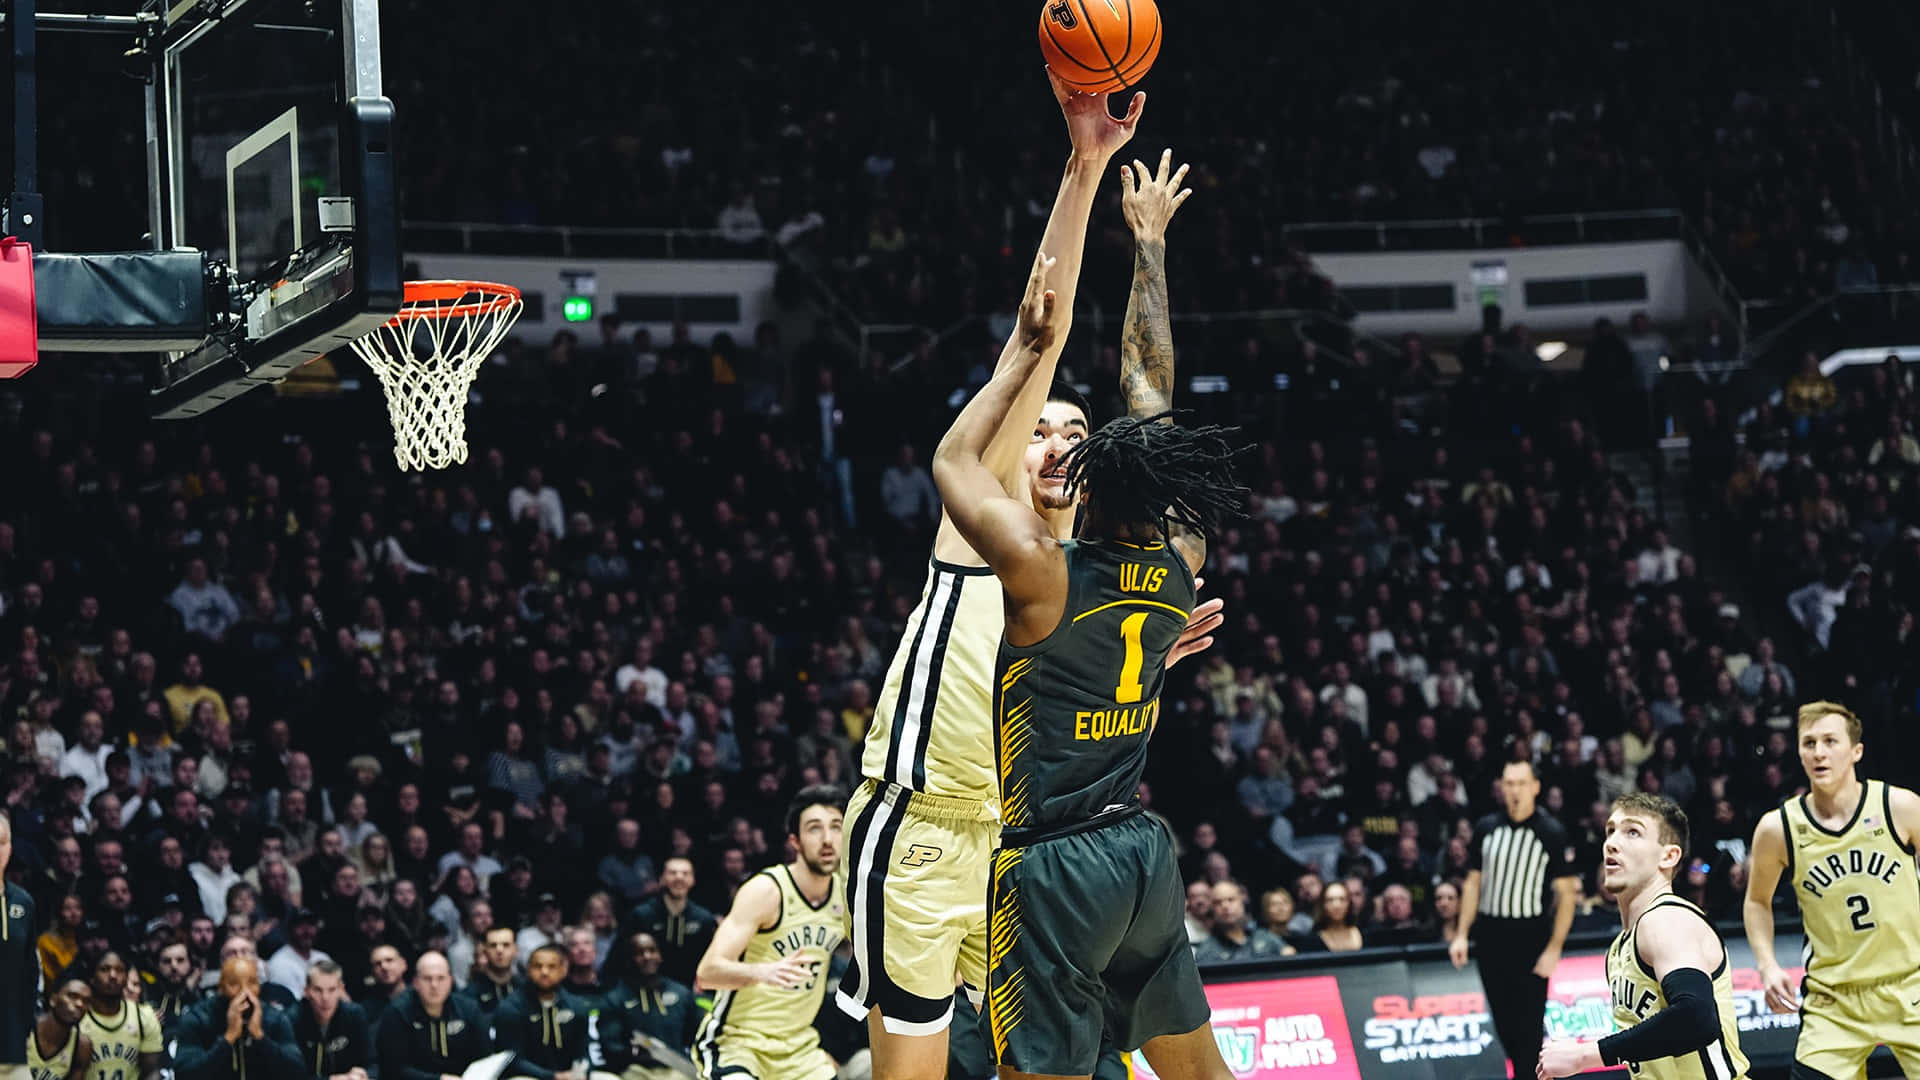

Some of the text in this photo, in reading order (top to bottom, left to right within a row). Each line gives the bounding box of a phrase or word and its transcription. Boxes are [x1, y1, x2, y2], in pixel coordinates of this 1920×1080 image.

[1119, 563, 1168, 593] ULIS
[1115, 611, 1150, 705] 1
[1074, 697, 1159, 741] EQUALITY
[899, 844, 942, 867] P
[1802, 849, 1901, 899] PURDUE
[1846, 894, 1876, 932] 2
[772, 925, 842, 957] PURDU
[1372, 992, 1486, 1020] SUPER
[1264, 1013, 1326, 1044] AUTO
[1364, 1011, 1491, 1050] START
[1260, 1038, 1337, 1070] PARTS
